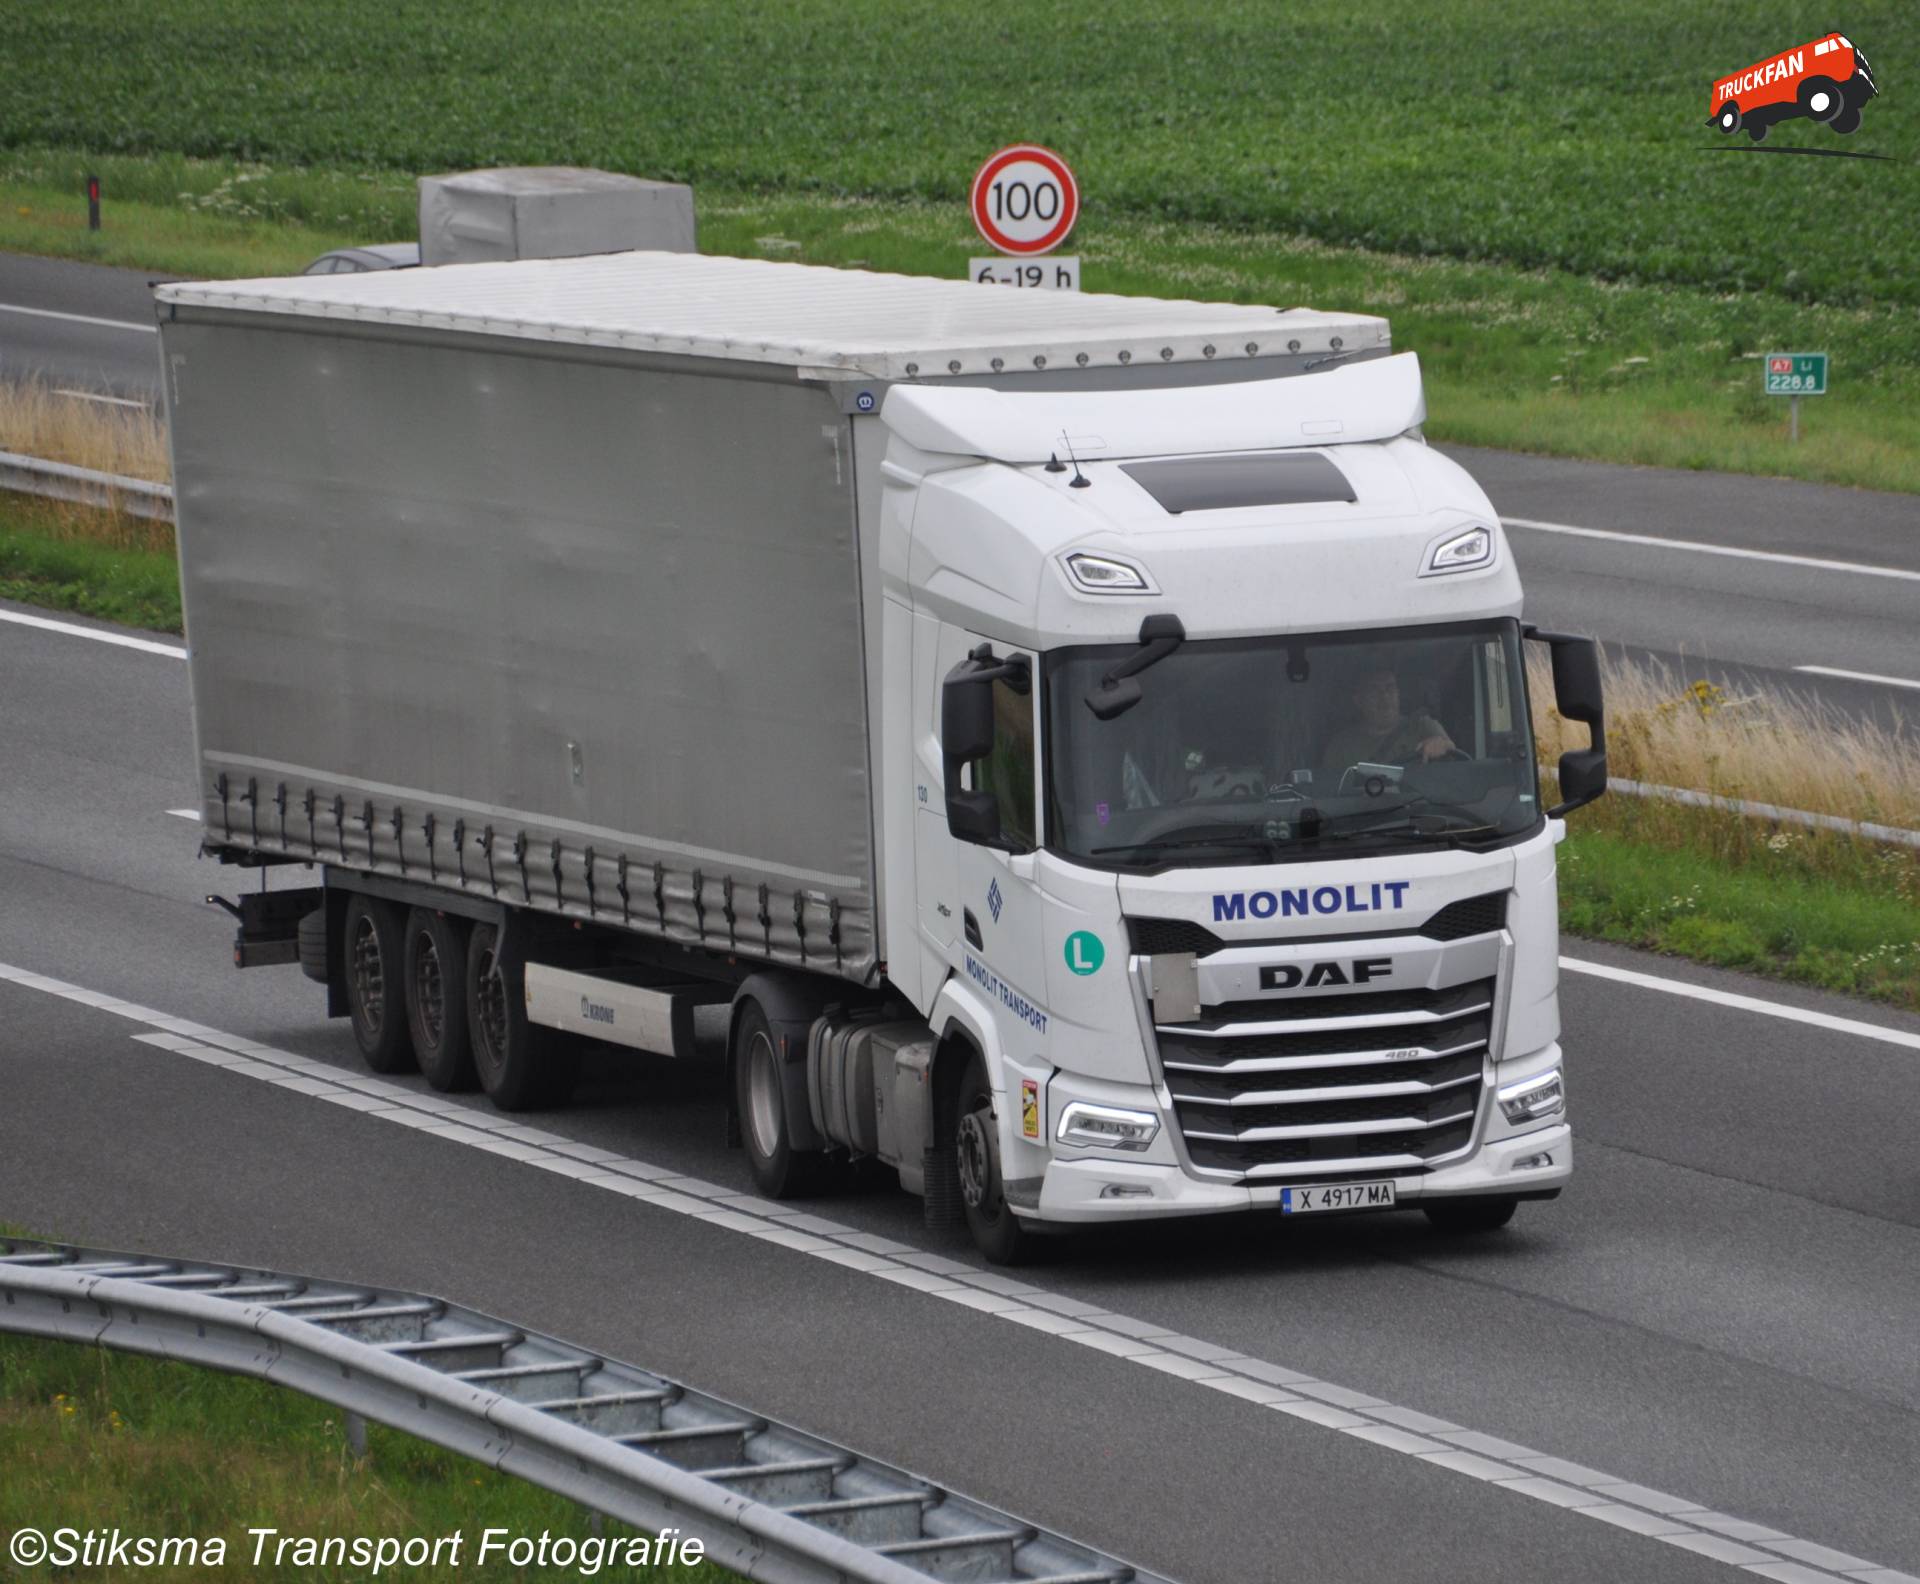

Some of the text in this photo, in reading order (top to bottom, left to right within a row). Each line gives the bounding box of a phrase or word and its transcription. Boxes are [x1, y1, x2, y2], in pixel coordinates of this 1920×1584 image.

[993, 181, 1058, 221] 100
[978, 265, 1071, 289] 6-19 h
[1773, 360, 1790, 371] A7
[917, 784, 928, 803] 130
[1212, 881, 1410, 922] MONOLIT
[1073, 938, 1093, 969] L
[1259, 957, 1393, 991] DAF
[966, 953, 1047, 1035] MONOLIT TRANSPORT
[1301, 1191, 1311, 1209] X
